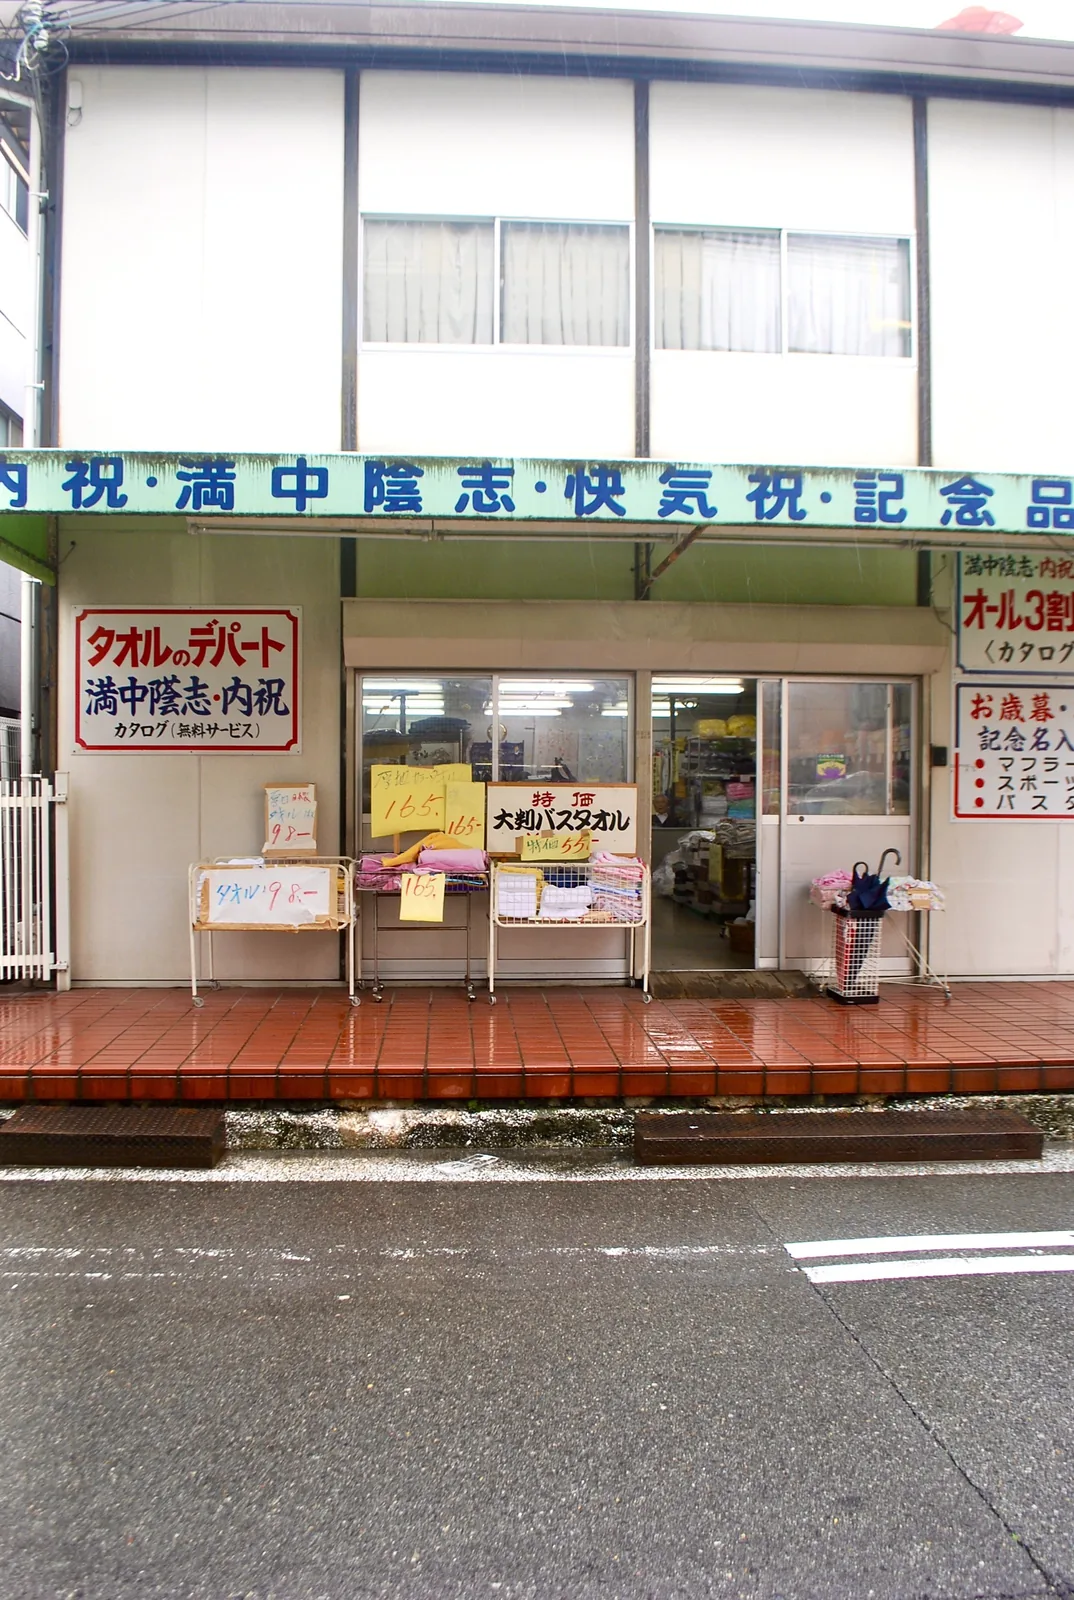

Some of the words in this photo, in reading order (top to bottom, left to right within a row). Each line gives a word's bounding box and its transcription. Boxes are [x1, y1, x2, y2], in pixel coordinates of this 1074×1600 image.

[87, 618, 286, 668] タオルのデパート
[84, 674, 290, 717] 満中陰志・内祝
[970, 692, 1074, 723] お歳暮・
[532, 791, 597, 808] 特価
[493, 808, 631, 832] 大判バスタオル
